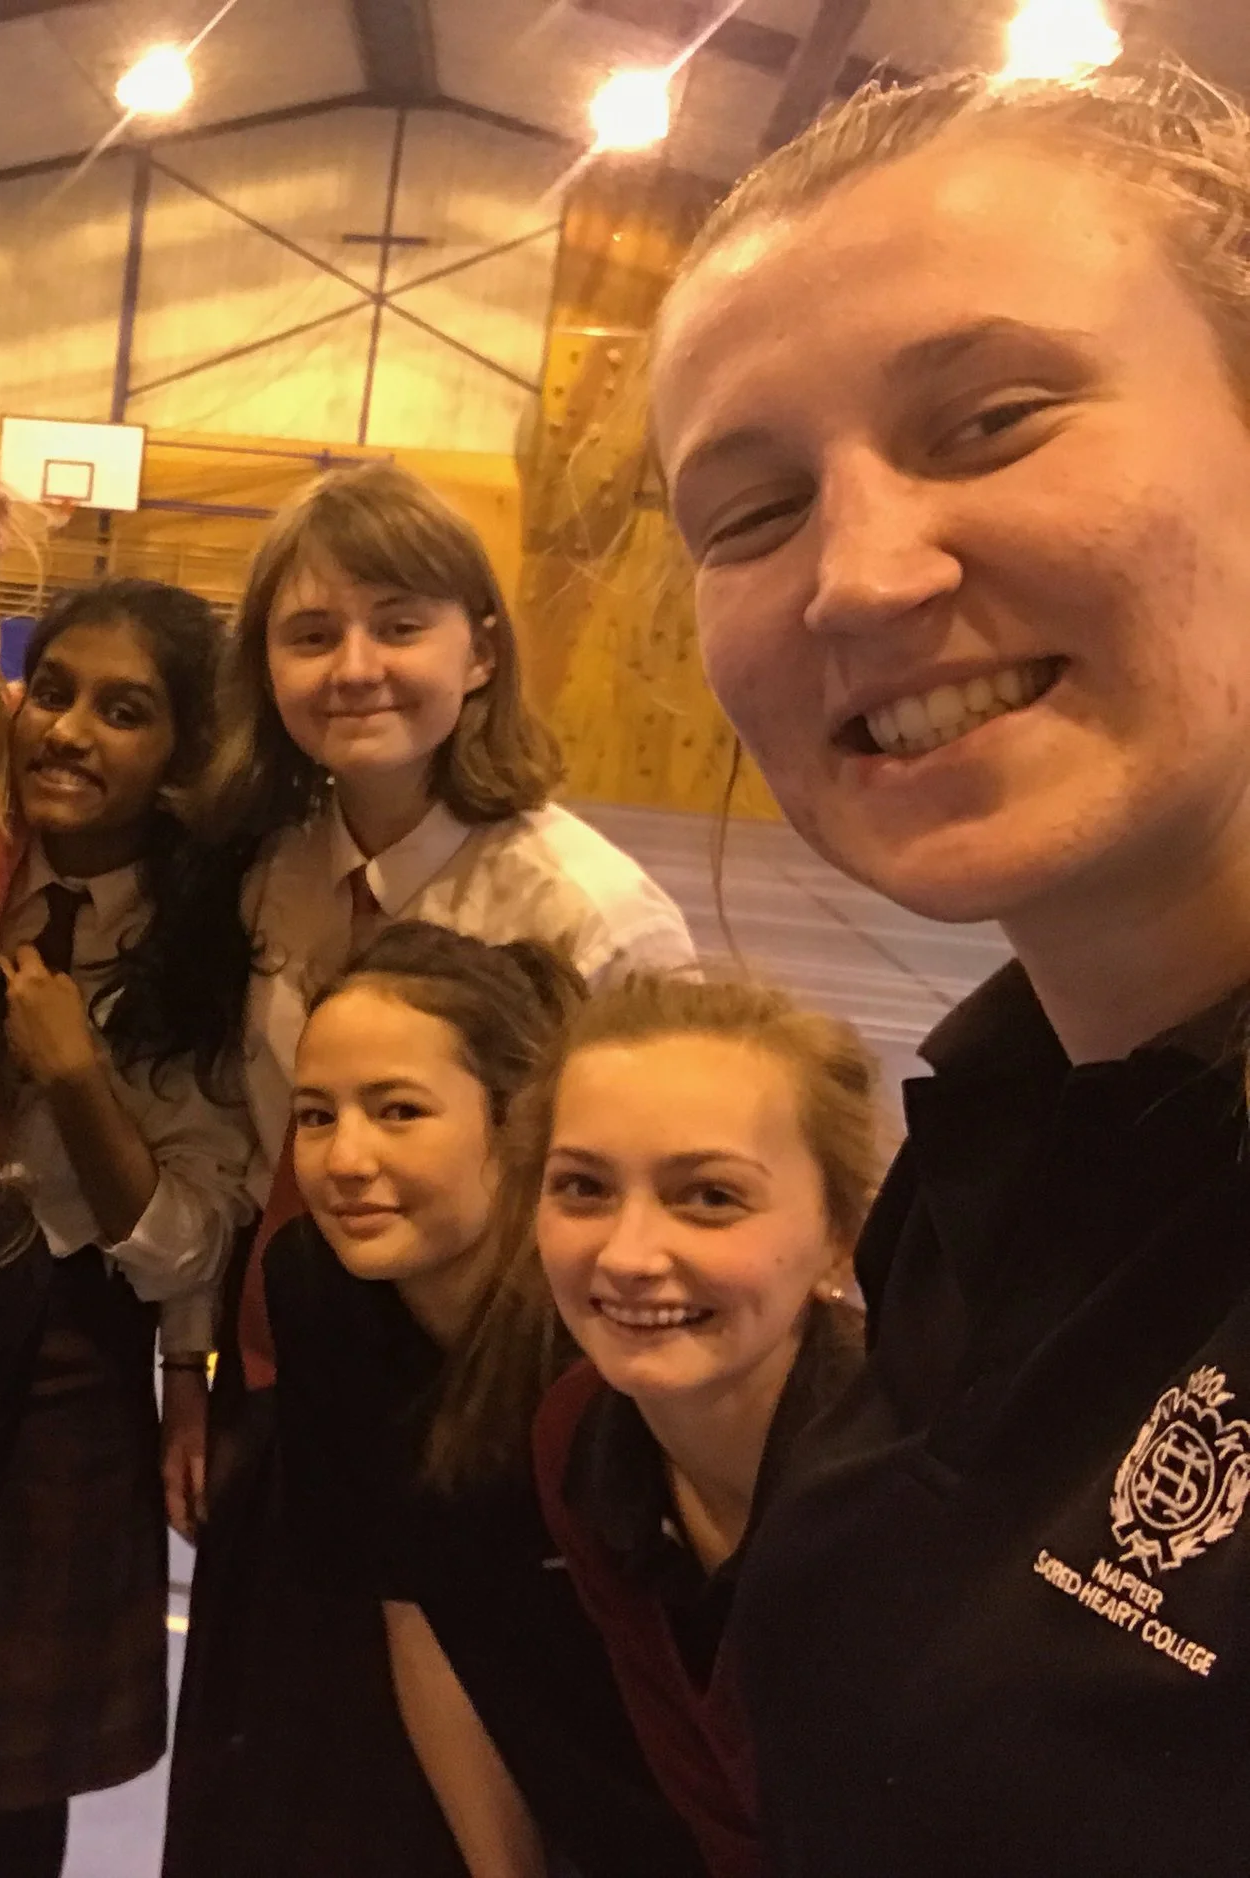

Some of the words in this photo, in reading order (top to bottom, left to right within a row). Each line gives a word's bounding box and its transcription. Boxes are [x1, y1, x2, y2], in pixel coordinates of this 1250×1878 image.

[1091, 1558, 1164, 1614] NAPIER
[1078, 1581, 1145, 1632] HEART
[1141, 1619, 1217, 1677] COLLEGE
